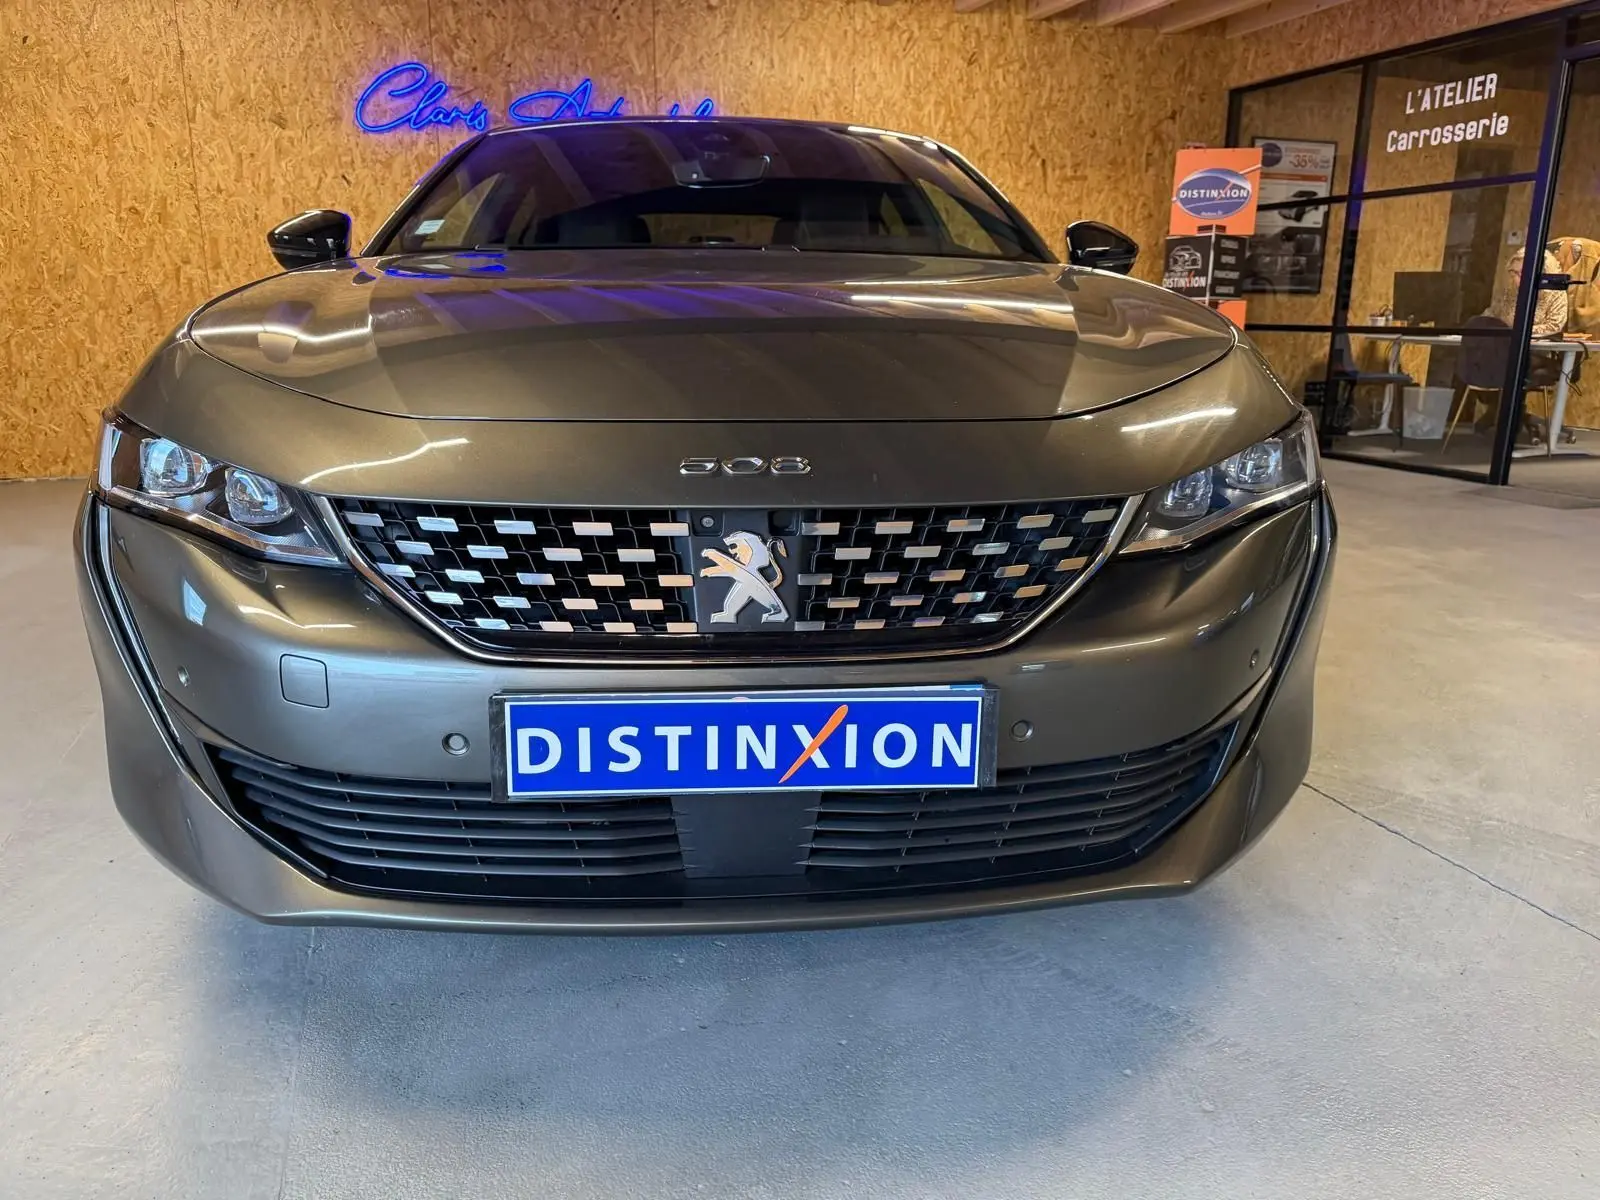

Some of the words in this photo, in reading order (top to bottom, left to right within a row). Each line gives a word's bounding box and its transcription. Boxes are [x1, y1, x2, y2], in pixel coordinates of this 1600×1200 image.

[356, 62, 488, 132] Claris
[1405, 72, 1498, 115] L'ATELIER
[1386, 111, 1510, 153] Carrosserie
[1179, 184, 1248, 200] DISTINXION
[679, 457, 812, 475] 508
[516, 705, 973, 783] DISTINXION
